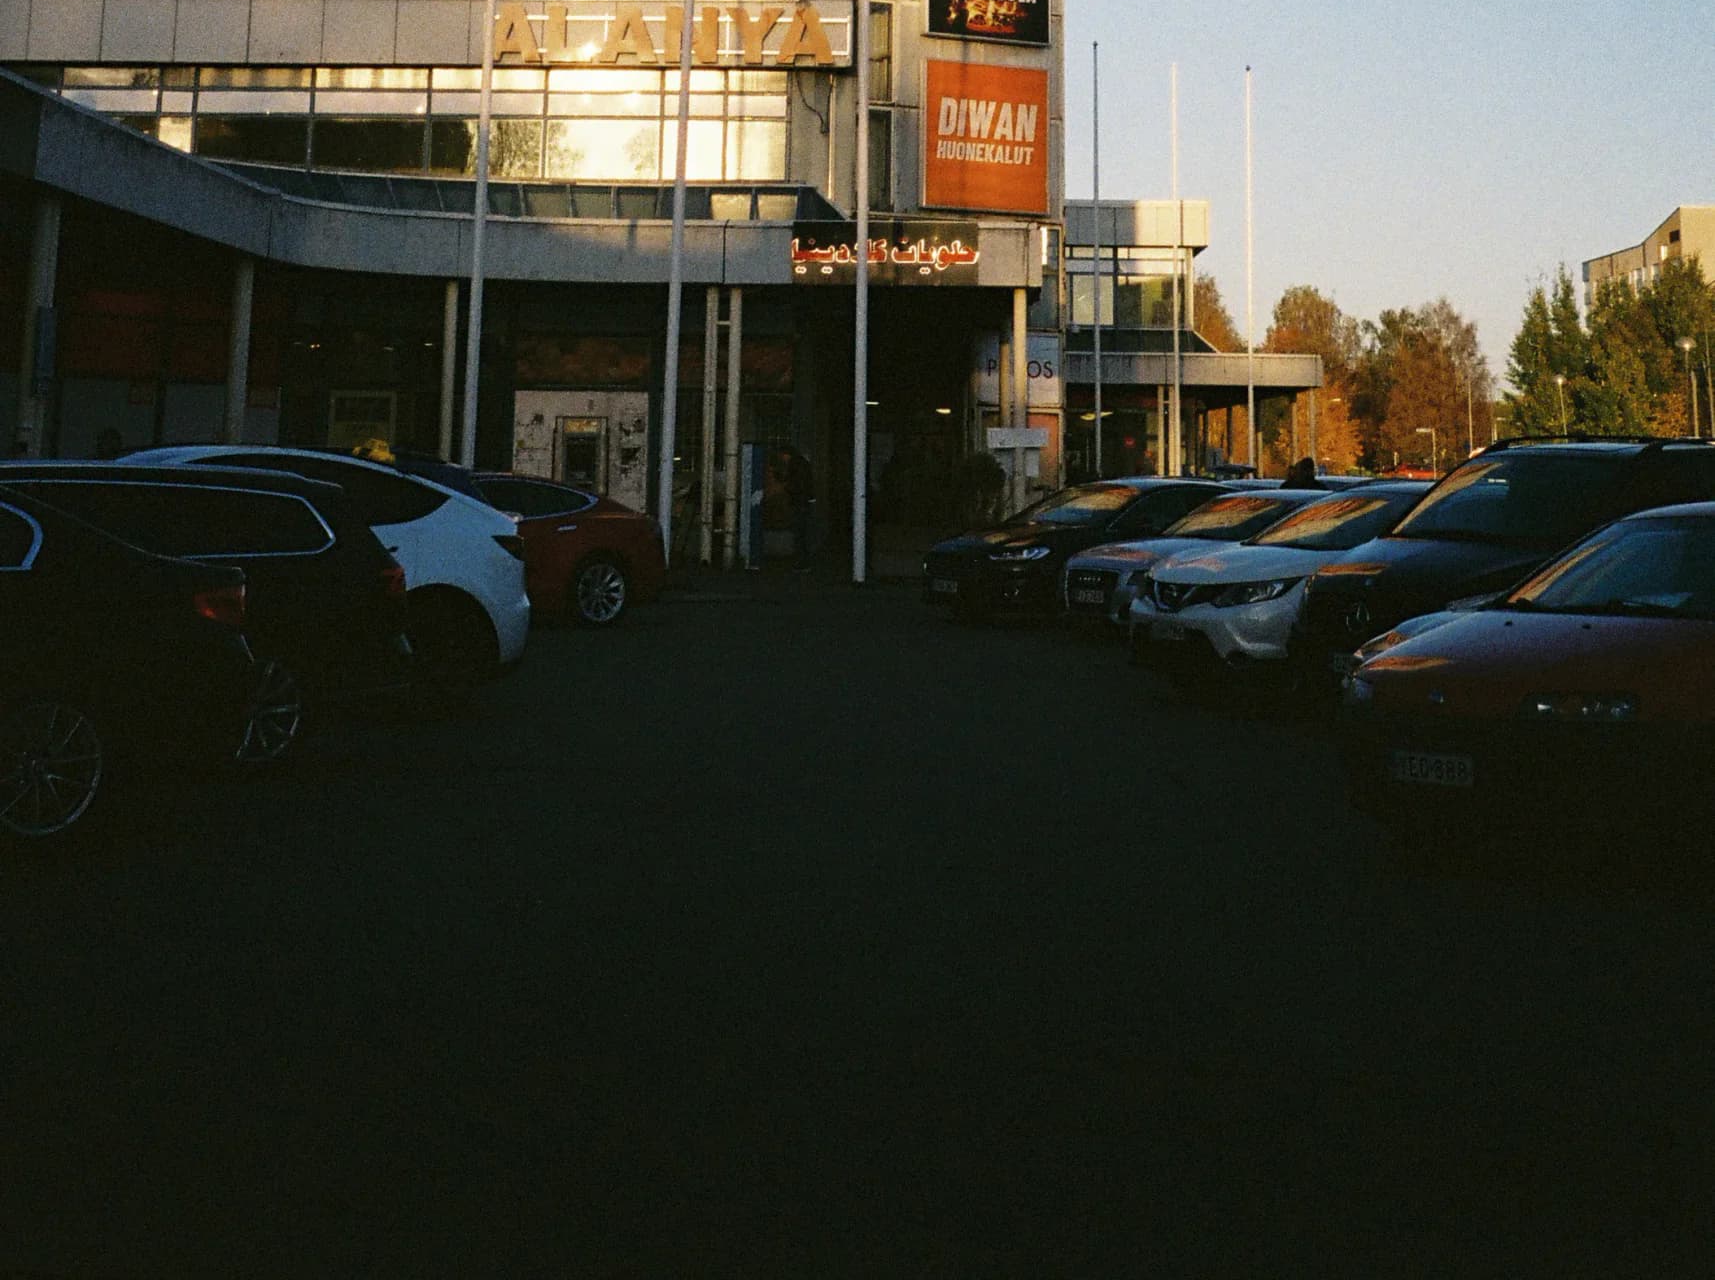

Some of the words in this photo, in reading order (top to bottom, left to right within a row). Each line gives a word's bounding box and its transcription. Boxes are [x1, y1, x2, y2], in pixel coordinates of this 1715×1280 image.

[493, 0, 834, 65] ALANYA
[938, 96, 1038, 143] DIWAN
[936, 140, 1034, 165] HUONEKALUT
[891, 235, 980, 275] حلويات
[987, 358, 1054, 379] POS
